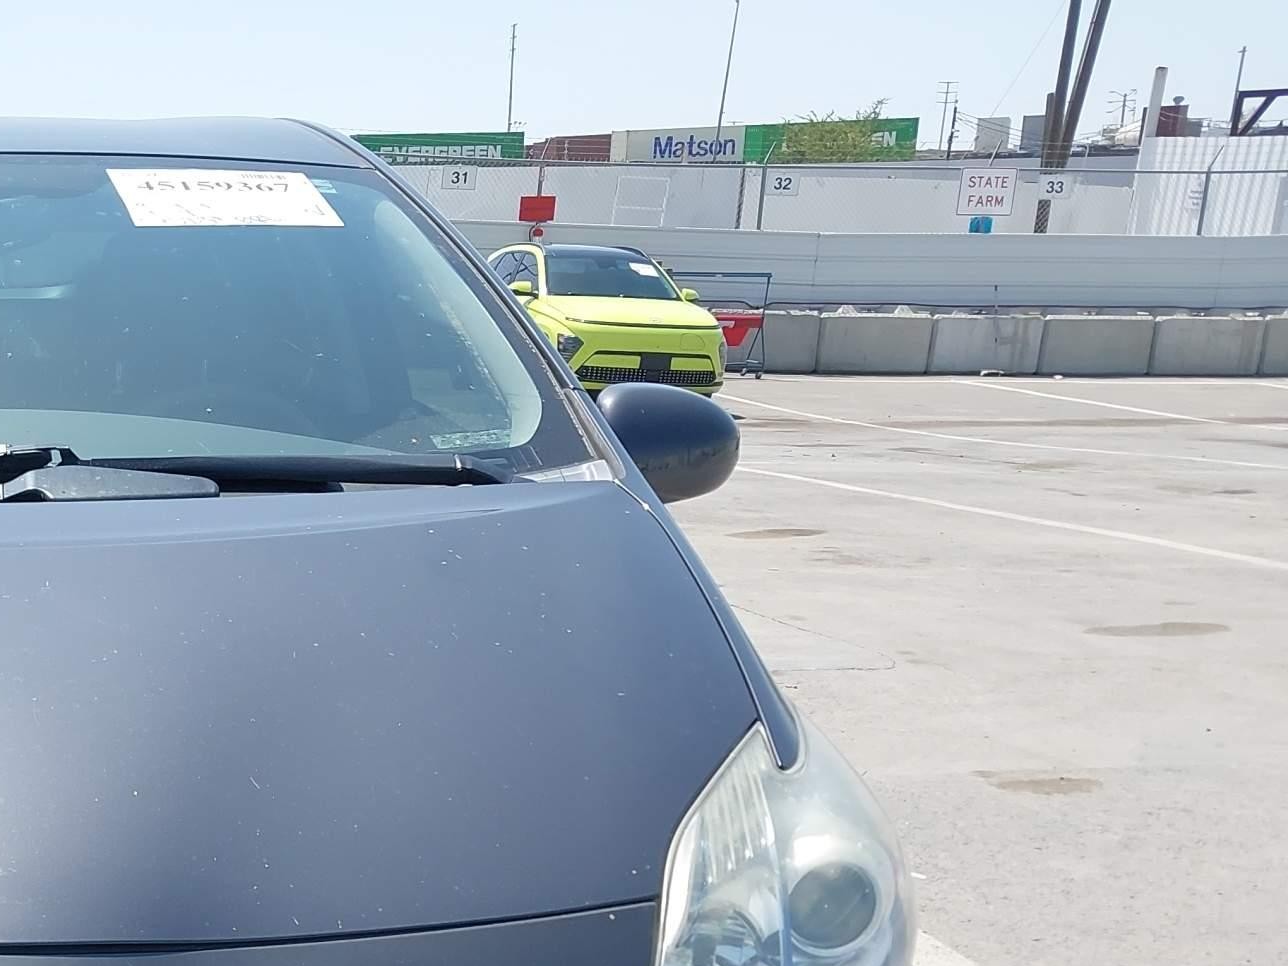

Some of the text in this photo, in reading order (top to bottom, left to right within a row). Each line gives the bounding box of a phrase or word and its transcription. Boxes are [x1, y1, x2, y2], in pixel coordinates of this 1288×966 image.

[653, 135, 736, 159] Matson
[451, 171, 468, 184] 31
[773, 176, 792, 190] 32
[968, 175, 1009, 189] STATE
[1046, 180, 1064, 194] 33
[967, 194, 1005, 208] FARM
